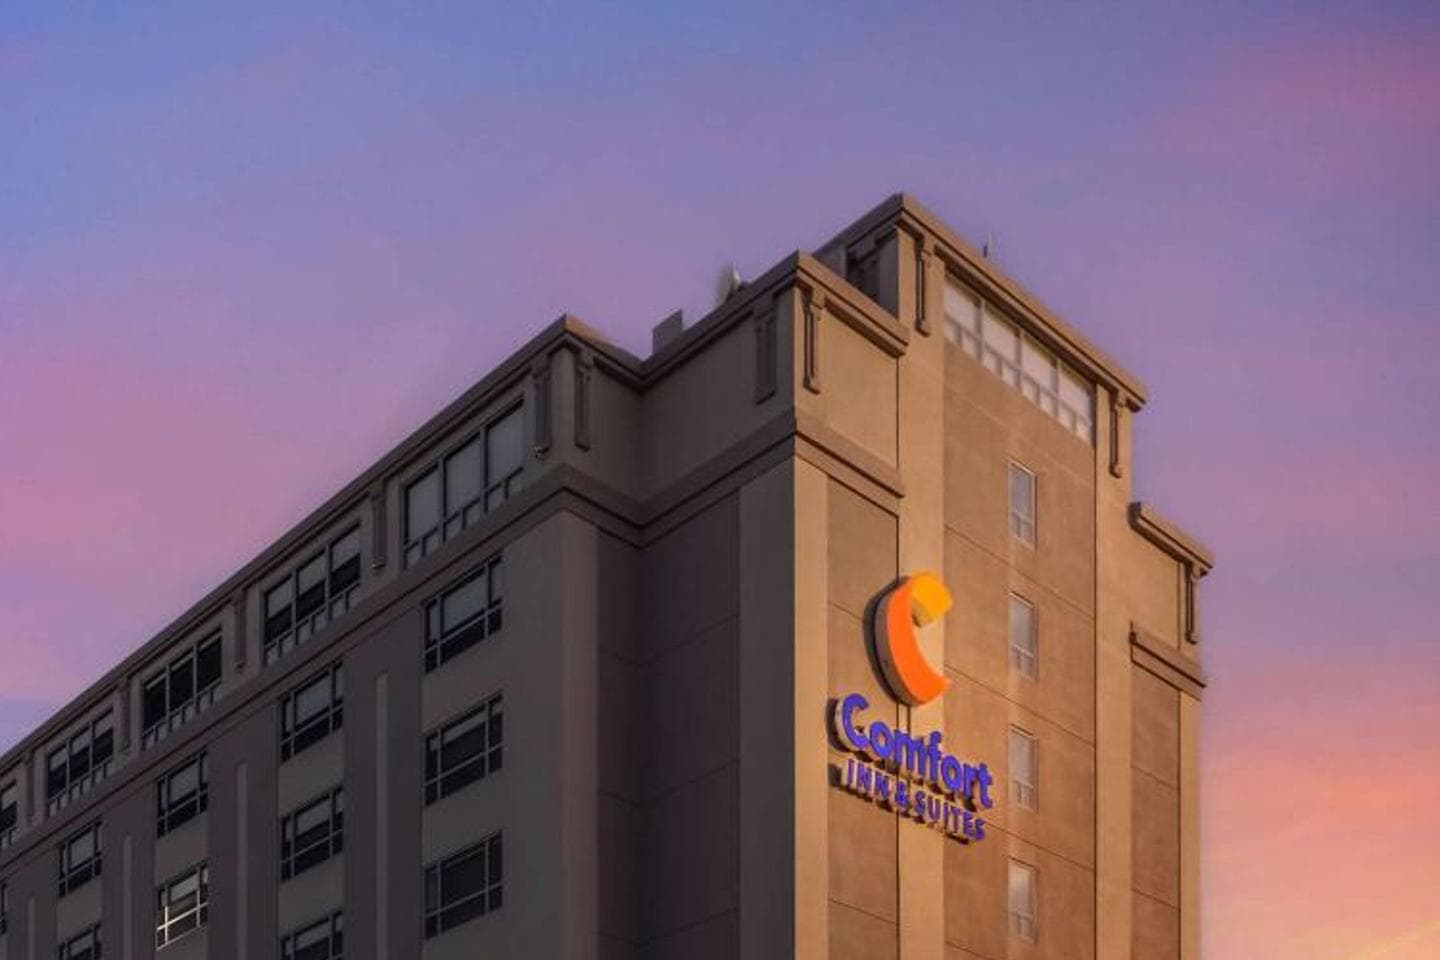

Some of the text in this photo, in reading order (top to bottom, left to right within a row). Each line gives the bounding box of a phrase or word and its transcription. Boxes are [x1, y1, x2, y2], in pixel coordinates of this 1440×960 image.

[840, 692, 993, 810] Comfort
[846, 758, 987, 842] INN & SUITES
